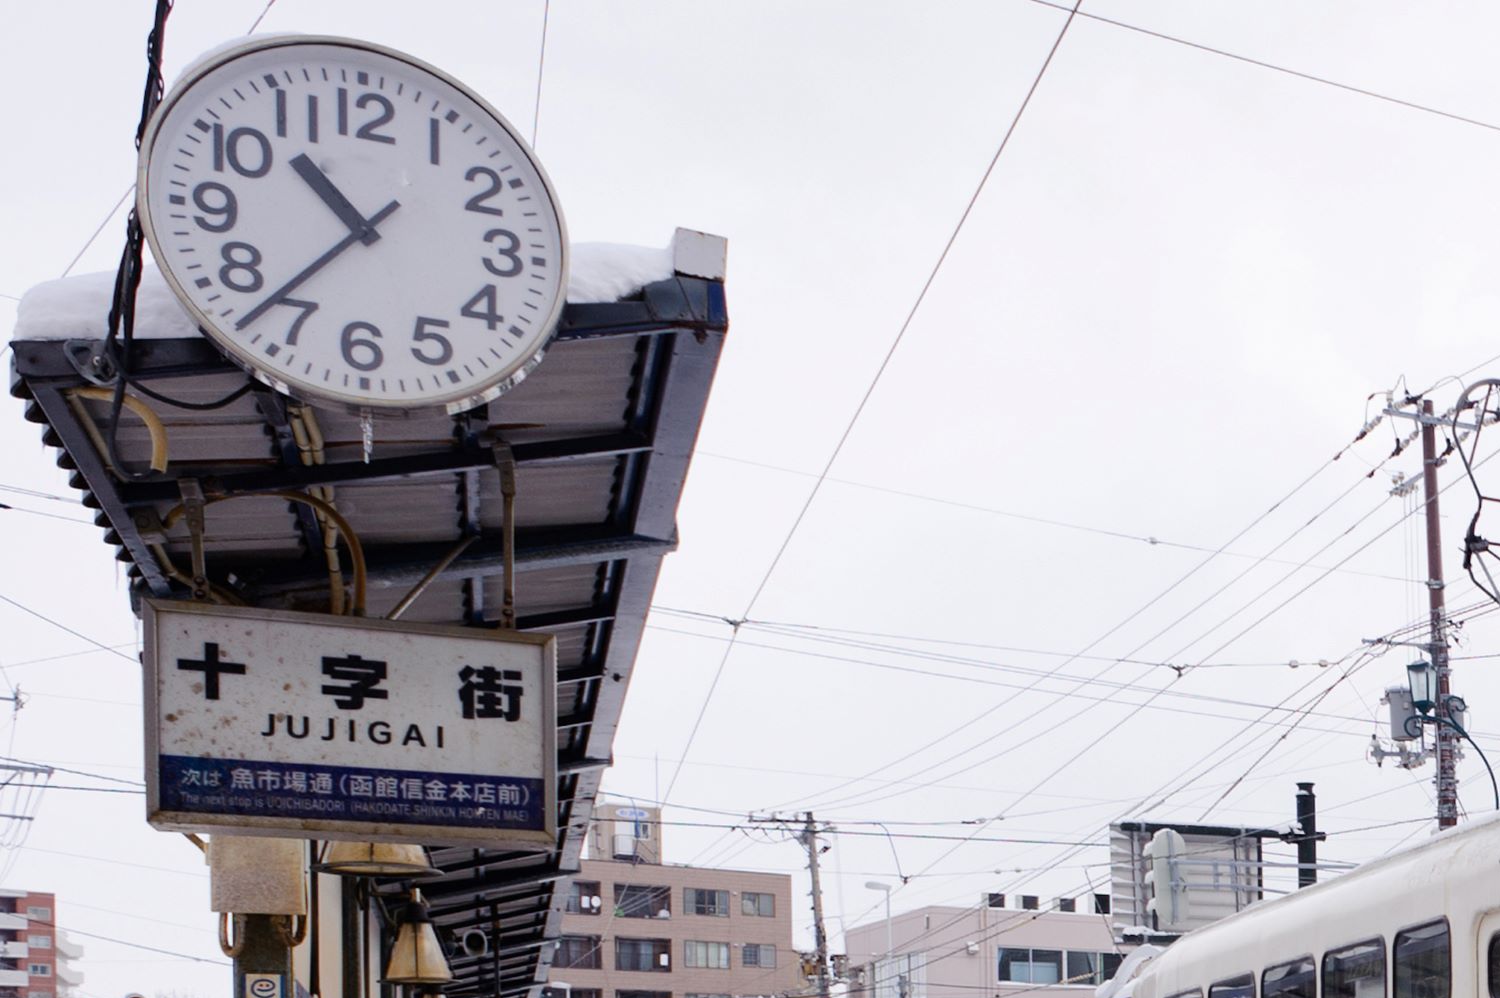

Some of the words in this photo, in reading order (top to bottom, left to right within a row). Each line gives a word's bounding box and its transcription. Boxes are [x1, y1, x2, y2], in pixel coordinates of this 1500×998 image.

[275, 89, 319, 144] 11
[337, 87, 396, 145] 12
[213, 123, 273, 179] 10
[429, 118, 440, 165] 1
[191, 181, 239, 233] 9
[464, 166, 504, 217] 2
[217, 241, 264, 293] 8
[481, 229, 523, 278] 3
[276, 297, 320, 347] 7
[460, 284, 505, 331] 4
[340, 321, 384, 371] 6
[411, 316, 454, 366] 5
[176, 642, 524, 723] 十字街
[261, 713, 444, 749] JUJIGAI
[180, 768, 222, 787] 次は
[229, 794, 251, 809] stop
[254, 797, 264, 808] is
[413, 804, 457, 818] SHINKIN
